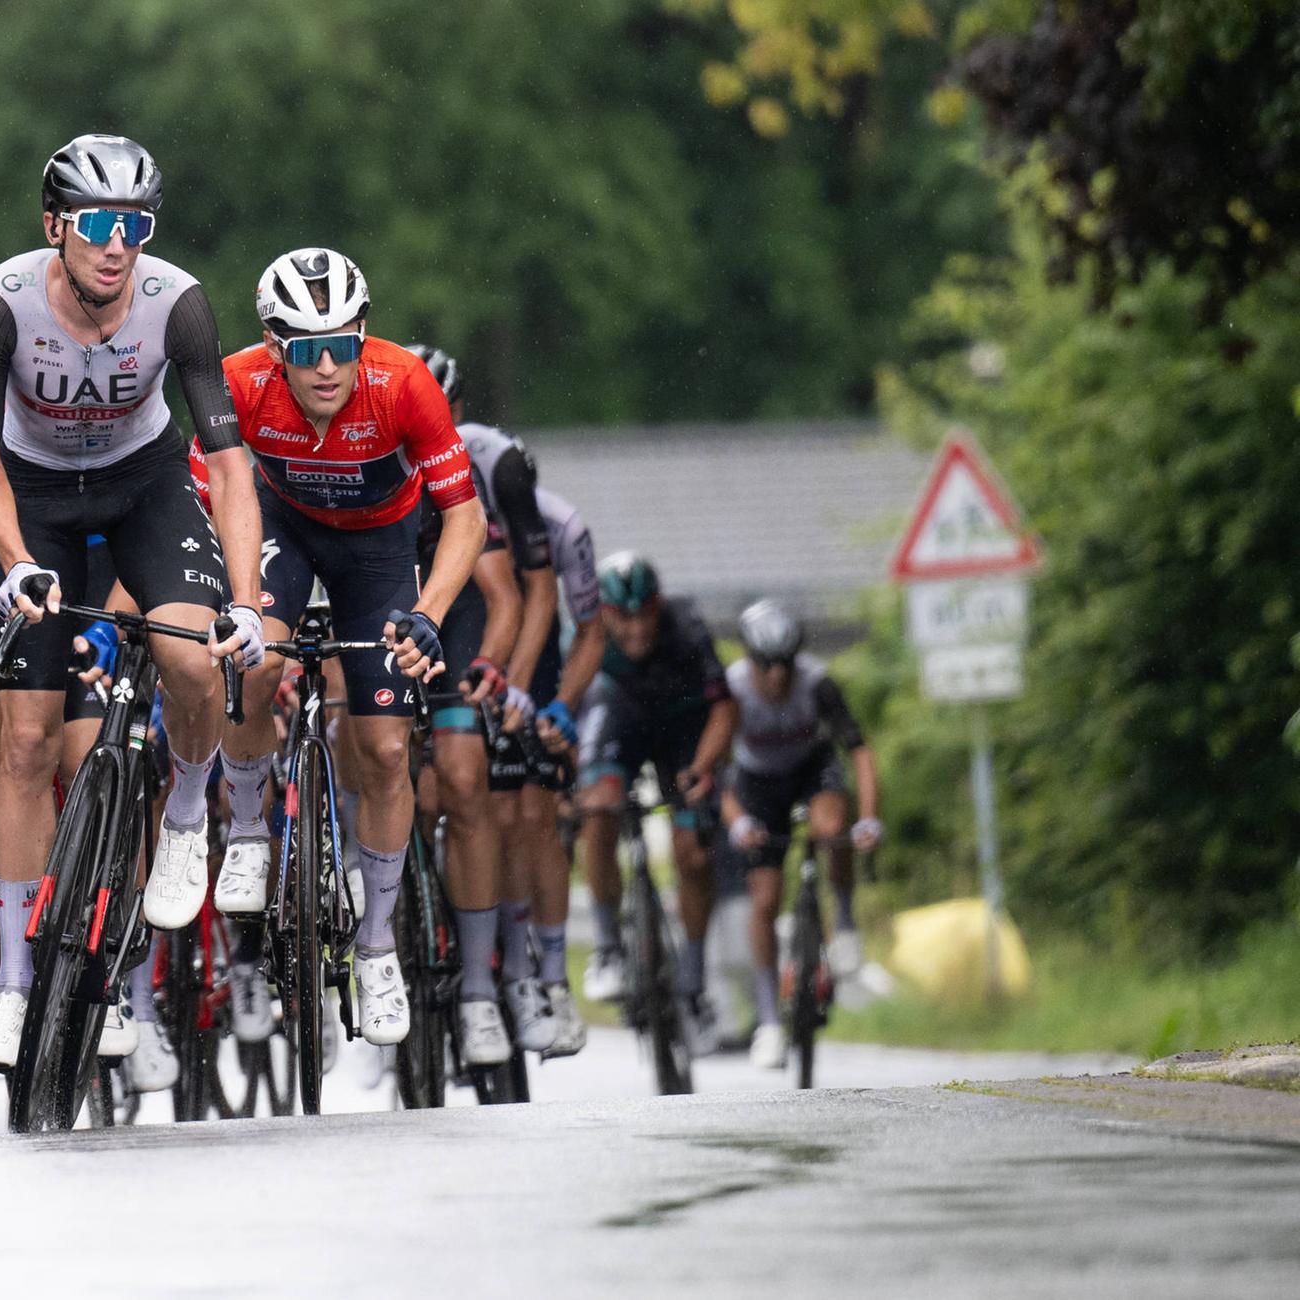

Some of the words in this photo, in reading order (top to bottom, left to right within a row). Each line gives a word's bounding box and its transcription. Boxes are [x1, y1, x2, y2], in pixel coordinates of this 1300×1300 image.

[1, 273, 37, 293] G42
[141, 275, 177, 297] G42
[39, 359, 63, 368] PISSEI
[35, 371, 139, 404] UAE
[55, 422, 114, 433] WHSH
[257, 425, 309, 444] Santini
[287, 471, 363, 484] SOUDAL
[427, 464, 471, 492] Santini
